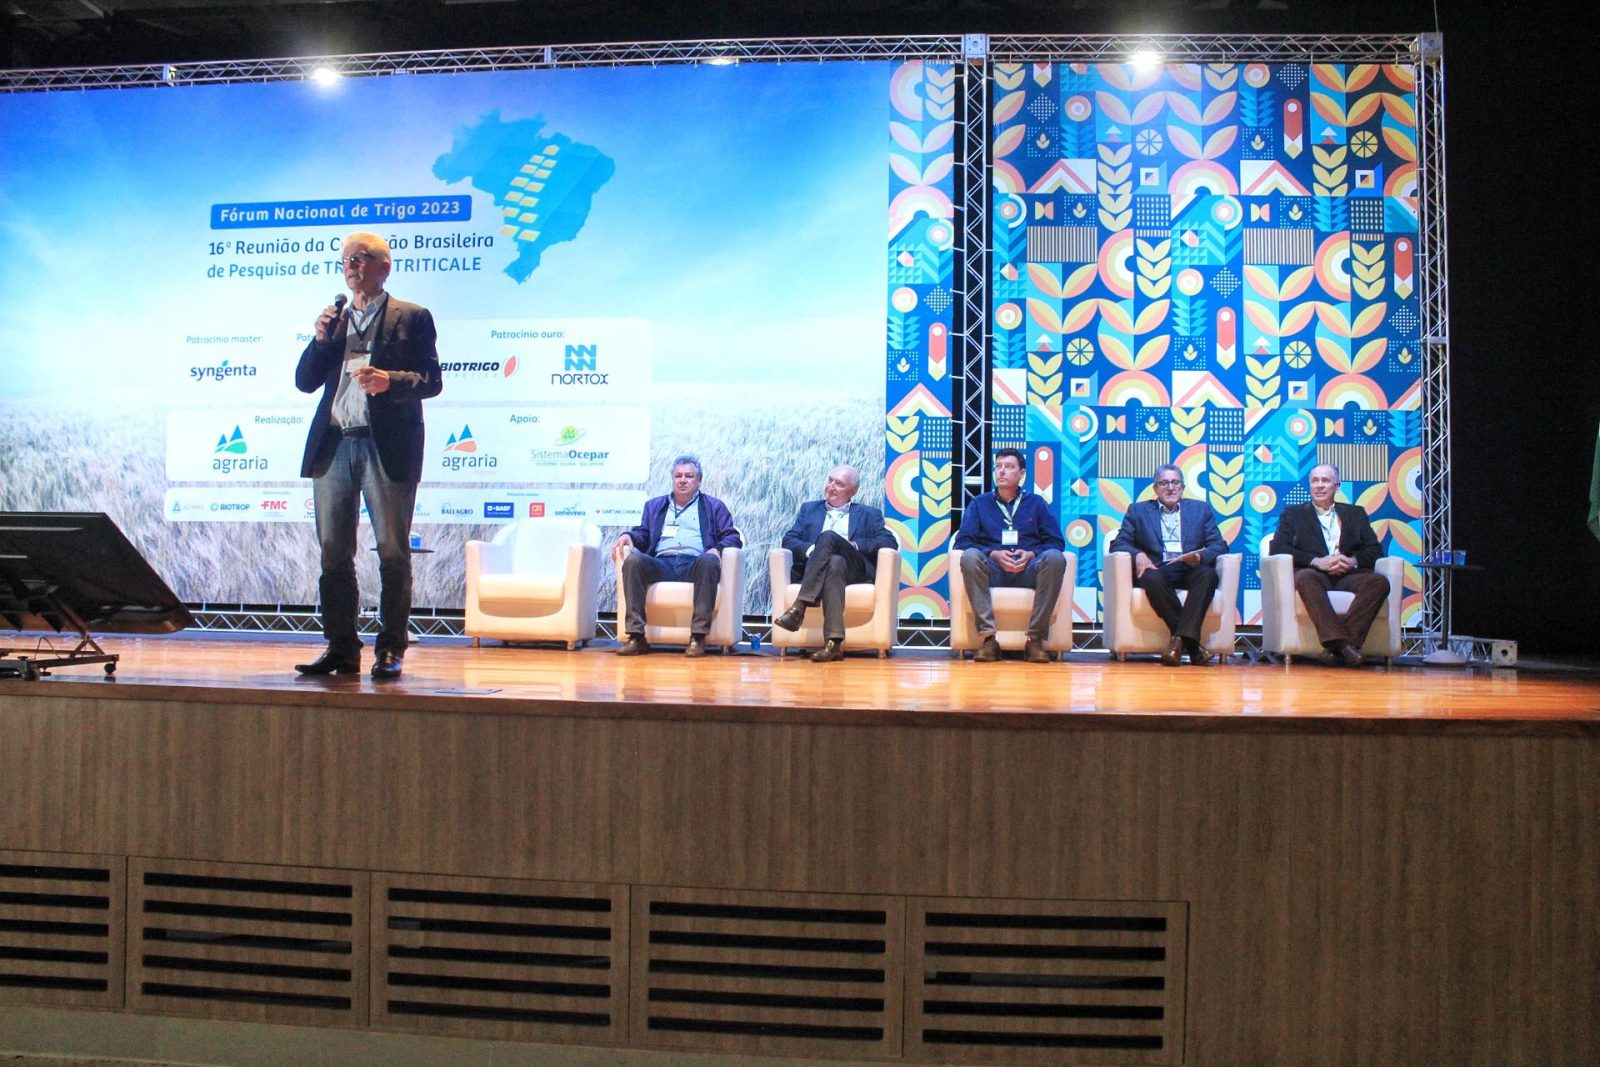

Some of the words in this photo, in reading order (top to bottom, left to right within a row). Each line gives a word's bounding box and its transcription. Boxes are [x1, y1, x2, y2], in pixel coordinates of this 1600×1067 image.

[220, 207, 269, 222] Fórum
[274, 204, 345, 221] Nacional
[351, 203, 368, 217] de
[374, 201, 416, 219] Trigo
[421, 201, 461, 215] 2023
[236, 238, 300, 254] Reunião
[305, 237, 325, 252] da
[415, 233, 494, 250] Brasileira
[207, 264, 224, 278] de
[229, 262, 297, 280] Pesquisa
[301, 261, 320, 275] de
[394, 257, 482, 272] TRITICALE
[190, 364, 257, 382] syngenta
[440, 361, 500, 372] BIOTRIGO
[254, 415, 305, 425] Realização:
[510, 414, 541, 425] Apoio:
[212, 456, 268, 473] agraria
[442, 454, 497, 471] agraria
[220, 503, 250, 511] BIOTROP
[261, 500, 288, 510] FMC
